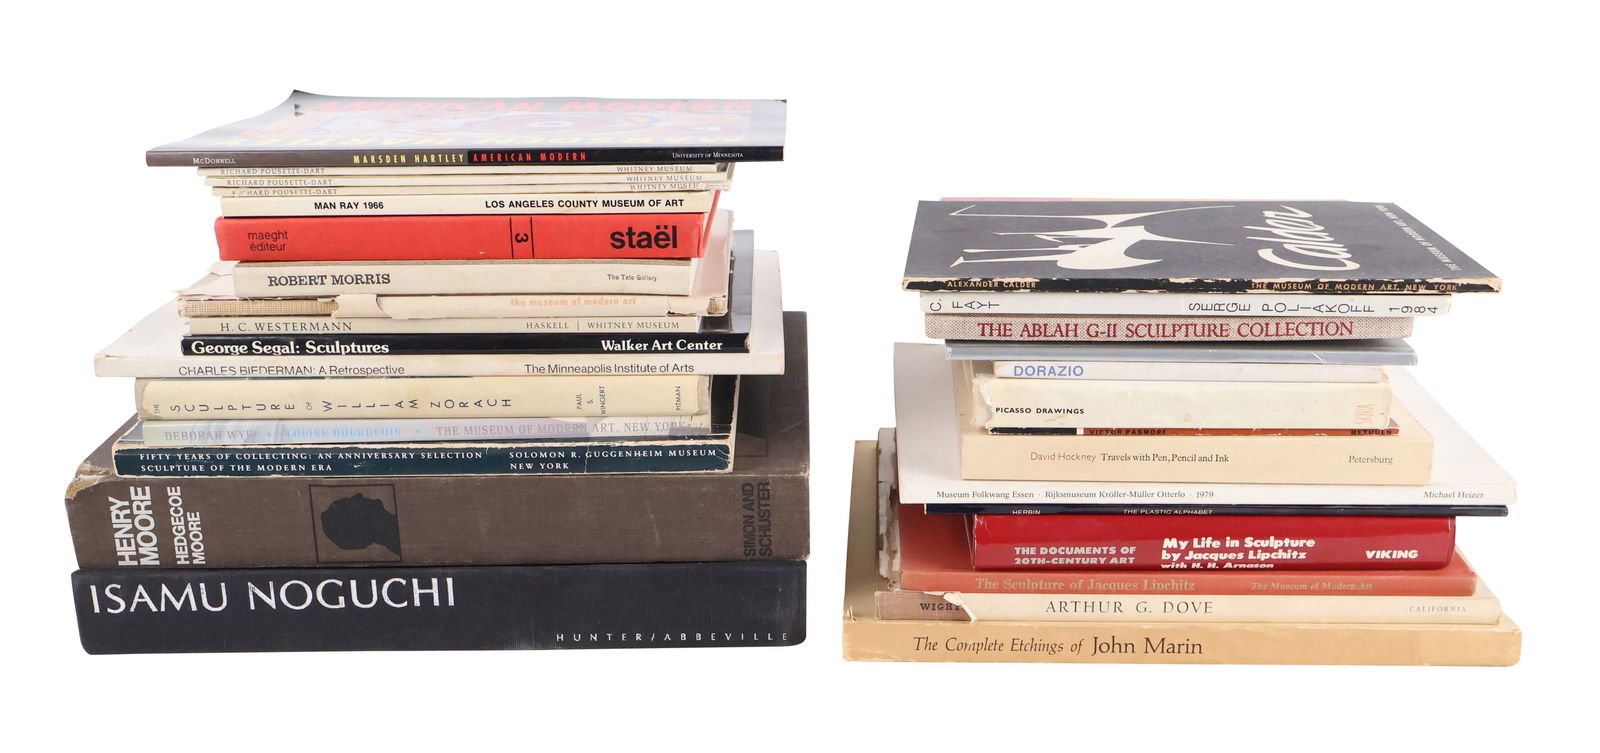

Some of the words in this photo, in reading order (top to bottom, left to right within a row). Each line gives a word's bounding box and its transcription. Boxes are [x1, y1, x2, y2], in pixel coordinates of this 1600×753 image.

[353, 155, 406, 164] MARSDEN
[414, 154, 465, 163] HARTLEY
[473, 153, 532, 162] AMERICAN
[540, 152, 587, 161] MODERN
[220, 167, 258, 175] RICHARD
[260, 166, 325, 174] POUSETTE-DART
[267, 178, 333, 186] POUSETTE-DART
[314, 201, 336, 210] MAN
[340, 201, 359, 210] RAY
[363, 201, 384, 210] 1966
[485, 201, 506, 209] LOS
[508, 200, 554, 209] ANGELES
[557, 200, 598, 208] COUNTY
[602, 199, 645, 208] MUSEUM
[648, 199, 661, 207] OF
[665, 199, 684, 207] ART
[246, 229, 288, 243] maeght
[610, 225, 678, 249] staël
[1243, 205, 1360, 271] Calder
[250, 242, 287, 252] éditeur
[268, 275, 327, 287] ROBERT
[331, 273, 391, 286] MORRIS
[1405, 283, 1427, 291] NEW
[1433, 283, 1458, 291] YORK
[1189, 302, 1251, 312] SERGE
[1262, 303, 1375, 313] POLIAKOFF
[1389, 305, 1438, 314] 1984
[221, 323, 235, 332] H.
[238, 322, 251, 332] C.
[255, 322, 352, 332] WESTERMANN
[526, 322, 569, 330] HASKELL
[587, 322, 633, 330] WHITNEY
[637, 321, 680, 330] MUSEUM
[977, 323, 1012, 338] THE
[1020, 323, 1078, 338] ABLAH
[1086, 323, 1119, 338] G-II
[1125, 323, 1230, 338] SCULPTURE
[1236, 322, 1354, 338] COLLECTION
[191, 341, 248, 357] George
[252, 341, 300, 357] Segal:
[305, 340, 390, 356] Sculptures
[601, 339, 649, 352] Walker
[651, 339, 674, 351] Art
[675, 338, 723, 352] Center
[178, 365, 236, 376] CHARLES
[319, 365, 328, 375] A
[329, 364, 406, 377] Retrospective
[524, 363, 545, 373] The
[547, 362, 611, 375] Minneapolis
[614, 361, 657, 373] Institute
[659, 361, 670, 372] of
[672, 362, 695, 373] Arts
[1014, 365, 1084, 377] DORAZIO
[170, 402, 295, 412] SCULPTURE
[306, 401, 313, 411] OF
[322, 399, 419, 412] WILLIAM
[430, 398, 511, 409] ZORACH
[236, 452, 312, 460] COLLECTING:
[421, 451, 482, 459] SELECTION
[509, 451, 565, 459] SOLOMON
[586, 450, 663, 458] GUGGENHEIM
[669, 449, 716, 457] MUSEUM
[1031, 452, 1055, 461] David
[1058, 452, 1097, 463] Hockney
[1101, 452, 1131, 462] Travels
[1133, 453, 1151, 462] with
[1153, 453, 1170, 463] Pen,
[1172, 453, 1196, 462] Pencil
[1198, 454, 1213, 462] and
[1216, 454, 1229, 462] Ink
[1349, 455, 1393, 465] Petersburg
[210, 464, 224, 472] OF
[230, 464, 251, 472] THE
[257, 464, 305, 472] MODERN
[741, 482, 754, 511] AND
[972, 491, 1010, 500] Folkwang
[1045, 490, 1097, 500] Rijksmuseum
[1099, 490, 1155, 498] Kröller-Müller
[131, 486, 160, 566] MOORE
[167, 486, 190, 565] HEDGECOE
[757, 482, 773, 558] SCHUSTER
[108, 496, 138, 566] HENRY
[741, 514, 756, 558] SIMON
[187, 511, 205, 565] MOORE
[1163, 538, 1189, 550] My
[1193, 538, 1221, 549] Life
[1226, 537, 1239, 548] in
[1244, 536, 1315, 549] Sculpture
[1015, 547, 1036, 555] THE
[1040, 546, 1116, 555] DOCUMENTS
[1120, 546, 1136, 554] OF
[1161, 550, 1181, 561] by
[1184, 551, 1244, 561] Jacques
[1248, 550, 1307, 560] Lipchitz
[1365, 550, 1419, 559] VIKING
[1015, 557, 1107, 565] 20TH-CENTURY
[976, 578, 998, 589] The
[1003, 579, 1064, 591] Sculpture
[1070, 578, 1084, 590] of
[1087, 579, 1139, 591] Jacques
[1143, 580, 1195, 591] Lipchitz
[1251, 582, 1268, 590] The
[1271, 582, 1307, 590] Museum
[1311, 582, 1319, 590] of
[1322, 582, 1356, 590] Modern
[90, 582, 228, 613] ISAMU
[248, 577, 455, 611] NOGUCHI
[1045, 601, 1124, 613] ARTHUR
[1135, 601, 1152, 613] G.
[1163, 601, 1213, 613] DOVE
[914, 637, 938, 651] The
[945, 637, 1004, 653] Complete
[1010, 638, 1064, 653] Etchings
[1070, 638, 1085, 654] of
[1091, 636, 1135, 656] John
[1144, 637, 1203, 654] Marin
